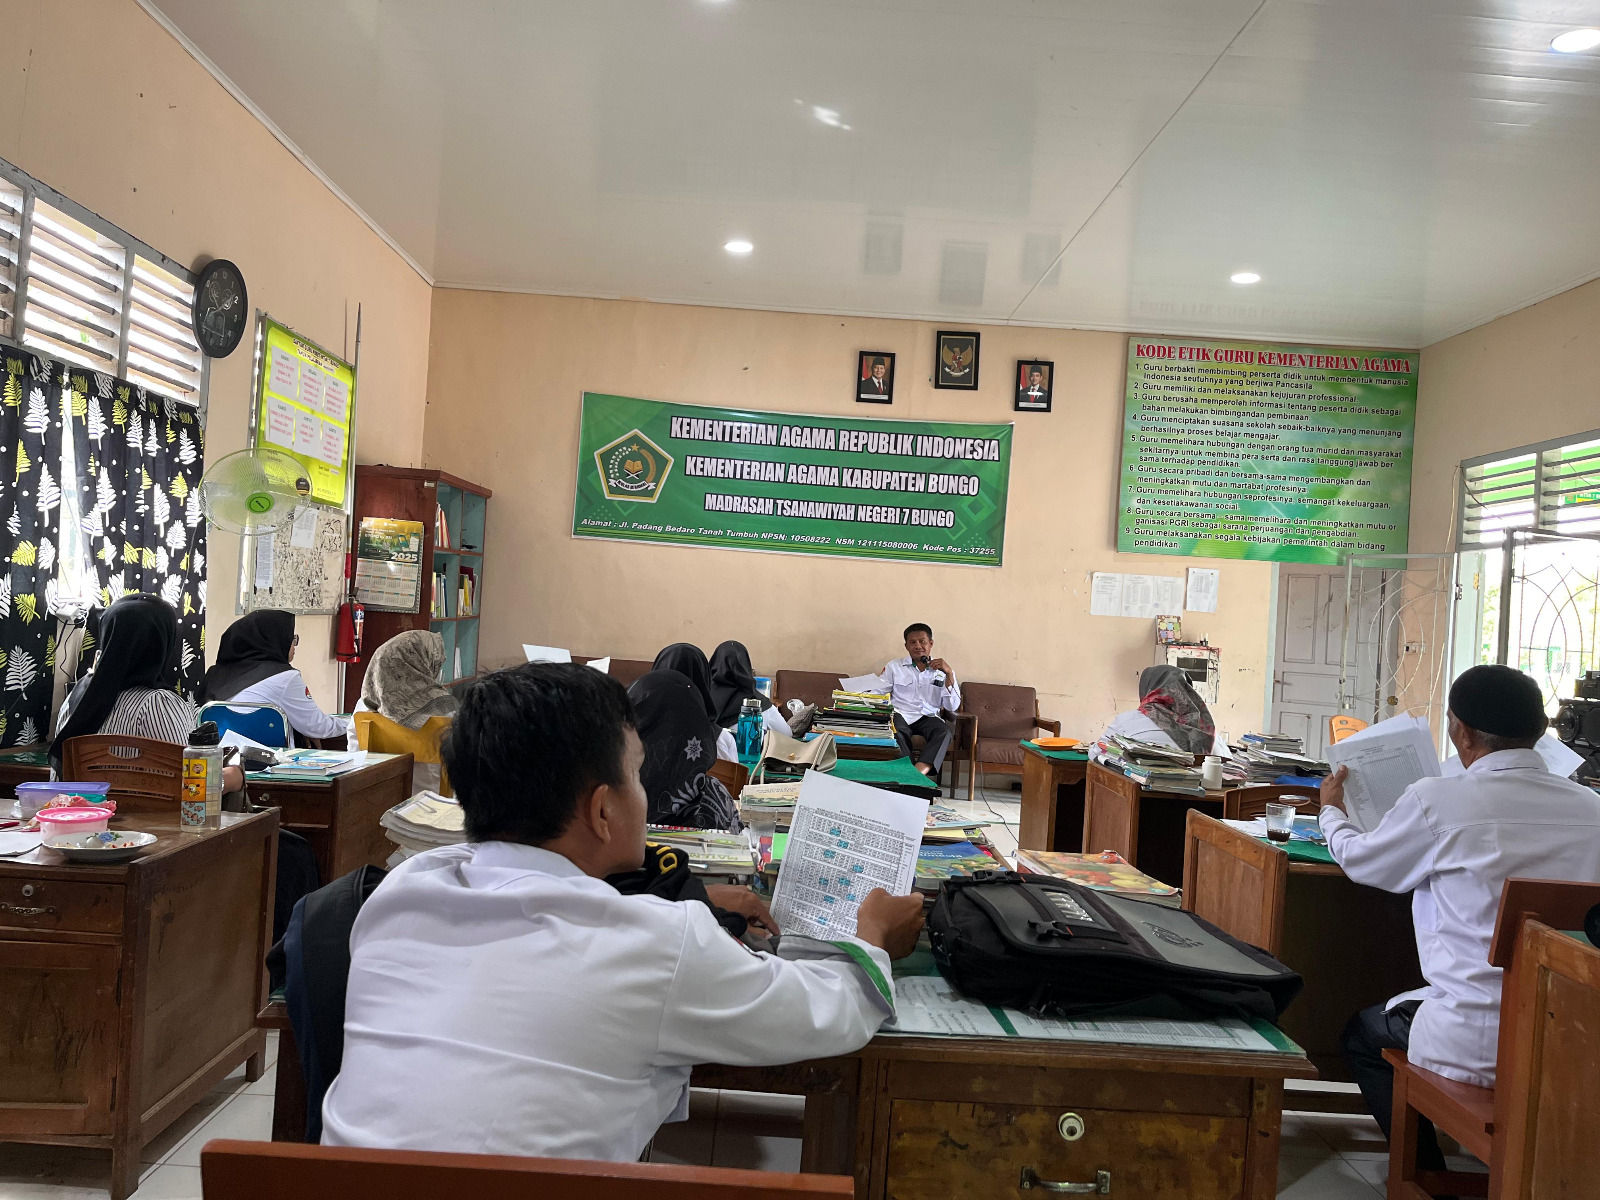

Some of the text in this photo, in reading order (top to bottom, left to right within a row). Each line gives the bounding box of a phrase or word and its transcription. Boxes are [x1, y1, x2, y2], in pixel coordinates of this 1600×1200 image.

[234, 295, 239, 305] 2
[1135, 343, 1410, 373] KODE ETIK GURU KEMENTERIAN AGAMA
[1143, 363, 1162, 371] Guru
[1164, 364, 1195, 373] berbakti
[1197, 366, 1246, 378] membimbing
[1249, 369, 1280, 380] perserta
[1283, 371, 1301, 379] didik
[1304, 373, 1325, 381] untuk
[1328, 374, 1373, 384] membentuk
[1375, 377, 1408, 386] manusia
[1143, 372, 1180, 381] Indonesia
[1245, 378, 1273, 388] berjiwa
[1275, 380, 1314, 389] Pancasila.
[1142, 382, 1161, 390] Guru
[1163, 384, 1195, 392] memiliki
[1213, 387, 1267, 397] melaksanakan
[1270, 390, 1305, 401] kejujuran
[1308, 392, 1358, 404] professional.
[1141, 393, 1160, 401] Guru
[1162, 394, 1197, 403] berusaha
[1200, 396, 1246, 408] memperoleh
[1249, 399, 1285, 408] informasi
[1287, 402, 1316, 412] tentang
[1318, 404, 1347, 414] peserta
[1350, 405, 1368, 413] didik
[1371, 407, 1401, 417] sebagai
[1142, 404, 1165, 412] bahan
[1167, 405, 1208, 414] melakukan
[1266, 411, 1310, 422] pembinaan.
[1140, 414, 1159, 422] Guru
[1161, 415, 1209, 427] menciptakan
[1246, 420, 1275, 429] sekolah
[1278, 422, 1335, 434] sebaik-baiknya
[1337, 427, 1356, 435] yang
[1358, 427, 1401, 438] menunjang
[1140, 424, 1280, 441] berhasilnya proses belajar mengajar.
[670, 416, 1000, 461] KEMENTERIAN AGAMA REPUBLIK INDONESIA
[1139, 435, 1158, 443] Guru
[1160, 436, 1204, 445] memelihara
[1206, 439, 1244, 449] hubungan
[1246, 441, 1274, 451] dengan
[1277, 445, 1299, 453] orang
[1357, 448, 1401, 459] masyarakat
[1139, 446, 1178, 456] sekitarnya
[1181, 448, 1202, 456] untuk
[1204, 450, 1239, 458] membina
[1260, 453, 1279, 461] serta
[1282, 454, 1296, 462] dan
[1317, 456, 1353, 467] tanggung
[1356, 459, 1378, 468] jawab
[1161, 456, 1194, 466] terhadap
[1197, 458, 1240, 469] pendidikan.
[685, 455, 980, 496] KEMENTERIAN AGAMA KABUPATEN BUNGO
[1137, 475, 1189, 487] meningkatkan
[1230, 481, 1263, 489] martabat
[1265, 483, 1308, 494] profesinya.
[1186, 467, 1212, 478] pribadi
[1214, 469, 1228, 477] dan
[1231, 470, 1286, 480] bersama-sama
[1288, 474, 1354, 486] mengembangkan
[1136, 486, 1155, 494] Guru
[1157, 487, 1200, 496] memelihara
[1203, 490, 1241, 501] hubungan
[1297, 496, 1334, 506] semangat
[1152, 498, 1212, 508] kesetiakawanan
[704, 493, 956, 528] MADRASAH TSANAWIYAH NEGERI 7 BUNGO
[1135, 507, 1153, 515] Guru
[1183, 510, 1215, 519] bersama
[1247, 514, 1290, 524] memelihara
[1293, 517, 1307, 525] dan
[1310, 518, 1363, 529] meningkatkan
[1366, 521, 1385, 529] mutu
[581, 518, 612, 527] Alamat
[631, 522, 663, 532] Padang
[665, 525, 696, 534] Bedaro
[698, 527, 724, 536] Tanah
[726, 529, 759, 538] Tumbuh
[760, 532, 788, 541] NPSN:
[790, 534, 831, 544] 10508222
[835, 538, 855, 546] NSM
[857, 539, 919, 550] 121115080006
[922, 543, 945, 552] Kode
[946, 545, 962, 553] Pos
[969, 547, 996, 555] 37255
[1135, 516, 1167, 527] ganisasi
[1169, 518, 1188, 526] PGRI
[1190, 520, 1220, 530] sebagai
[1250, 523, 1293, 534] perjuangan
[1295, 526, 1309, 534] dan
[1311, 527, 1359, 538] pengabdian.
[1134, 527, 1153, 535] Guru
[1155, 529, 1211, 539] melaksanakan
[1214, 532, 1240, 542] segala
[1243, 534, 1280, 545] kebijakan
[1283, 536, 1327, 548] pemerintah
[1330, 539, 1354, 547] dalam
[1357, 541, 1385, 551] bidang
[1134, 538, 1180, 549] pendidikan.
[391, 552, 418, 562] 2025
